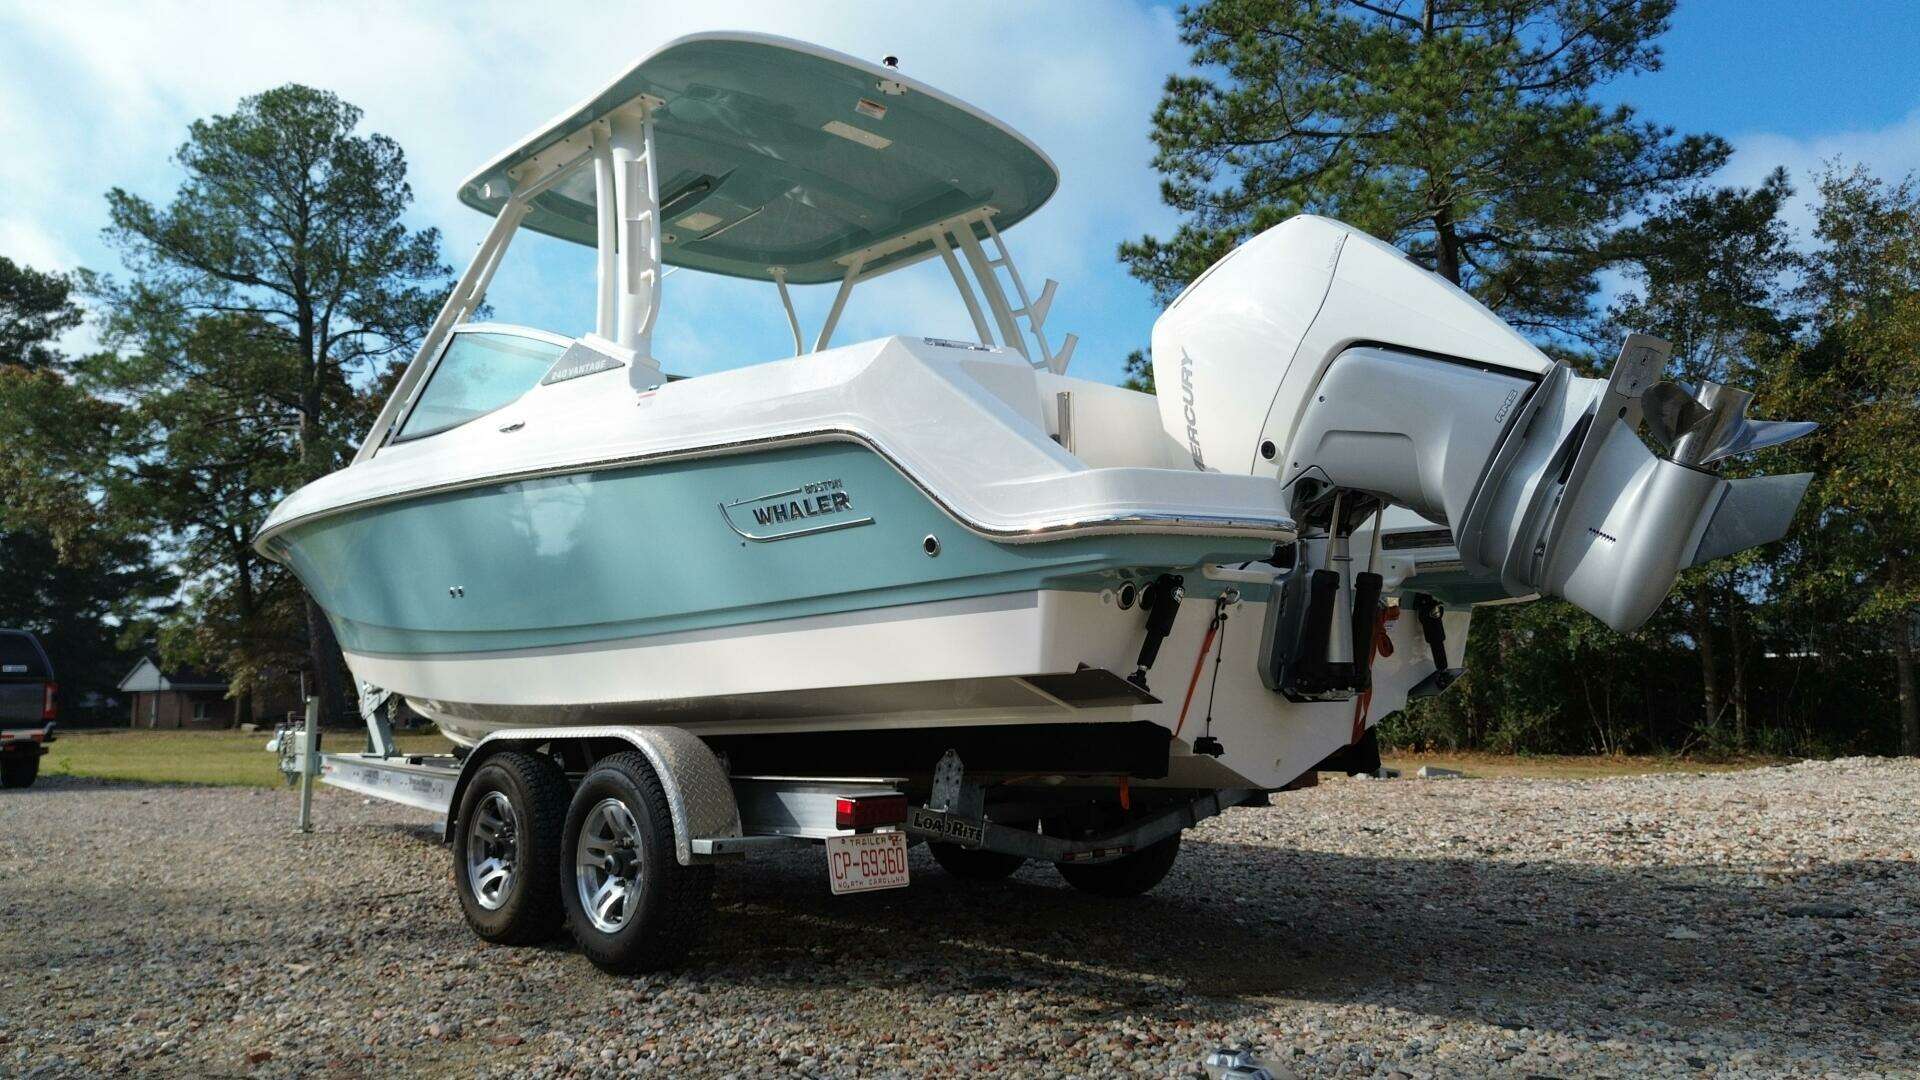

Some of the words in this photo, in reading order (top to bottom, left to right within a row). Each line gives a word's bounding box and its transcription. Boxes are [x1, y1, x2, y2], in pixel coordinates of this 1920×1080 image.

[551, 369, 568, 380] 240
[568, 359, 607, 376] VANTAGE
[804, 479, 843, 494] BOSTON
[752, 491, 853, 526] WHALER
[850, 837, 887, 847] TRAILER
[833, 847, 905, 880] CP-69360
